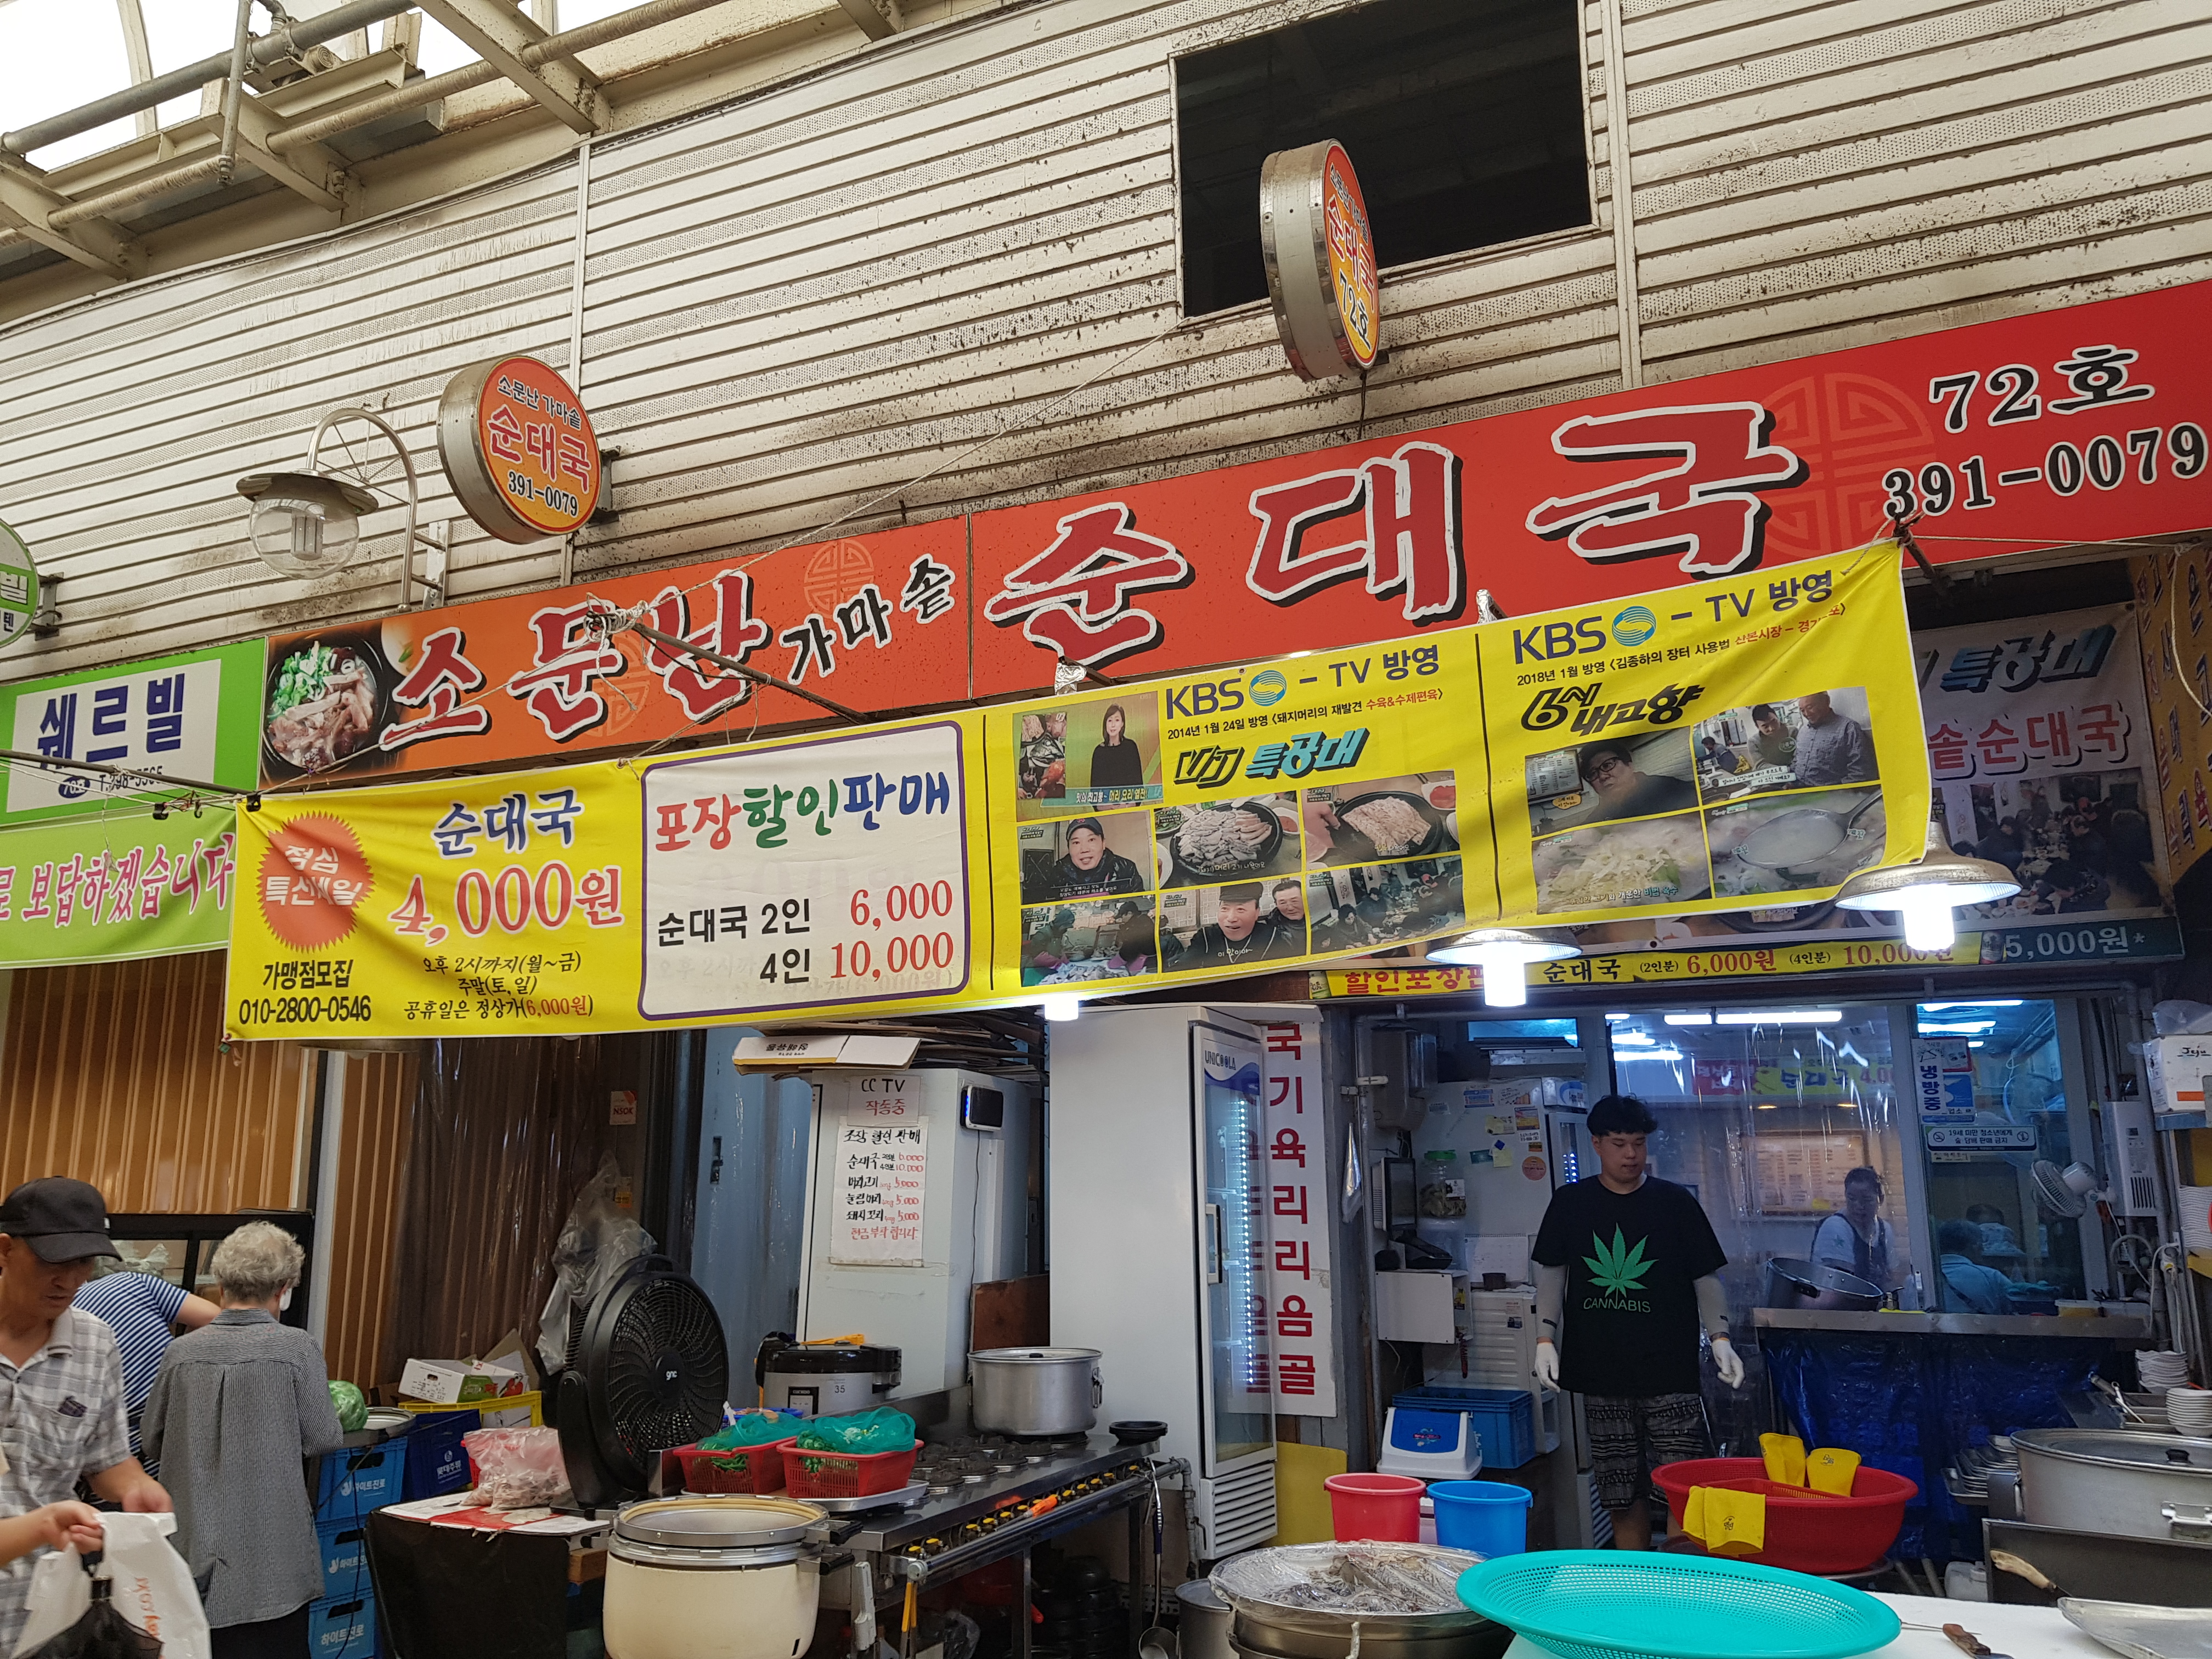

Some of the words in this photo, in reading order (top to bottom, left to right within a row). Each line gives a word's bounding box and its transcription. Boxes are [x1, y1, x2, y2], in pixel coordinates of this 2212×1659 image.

[1327, 194, 1375, 314] 순대국
[1339, 267, 1372, 352] 72호
[497, 374, 540, 411] 소문난
[541, 394, 582, 431] 가마솥
[1928, 343, 2155, 434] 72호
[487, 404, 591, 494] 순대국
[1882, 421, 2209, 521] 391-0079
[508, 469, 579, 517] 391-0079
[380, 568, 772, 751] 소문난
[779, 552, 957, 686] 가마솥
[983, 399, 1810, 669] 순대국
[1513, 616, 1606, 664] KBS
[1706, 588, 1756, 622] TV
[1769, 569, 1833, 611] 방영
[1166, 677, 1245, 720] KBS
[1328, 658, 1372, 687] TV
[1382, 644, 1440, 680] 방영
[1517, 670, 1556, 686] 2018년
[1560, 667, 1578, 680] 1월
[1582, 661, 1606, 676] 방영
[1667, 646, 1690, 661] 장터
[1695, 638, 1731, 656] 사용법
[1735, 625, 1782, 646] 산본시장
[1940, 623, 2117, 693] 특공대
[37, 673, 185, 770] 쉐르빌
[1167, 725, 1201, 740] 2014년
[1204, 722, 1220, 734] 1월
[1223, 719, 1245, 732] 24일
[1248, 715, 1268, 728] 방영
[1331, 701, 1363, 715] 재발견
[1521, 682, 1602, 731] 6시
[1570, 682, 1705, 736] 내고향
[1173, 744, 1245, 789] VJ
[1244, 727, 1371, 778] 특공대
[430, 785, 584, 859] 순대국
[21, 832, 236, 928] 보답하겠습니다
[387, 859, 625, 947] 4,000원
[658, 905, 748, 947] 순대국
[761, 898, 811, 935] 2인
[850, 879, 953, 931] 6,000
[262, 959, 354, 991] 가맹점모집
[423, 955, 449, 974] 오후
[455, 951, 582, 974] 2시까지(월~금)
[759, 948, 811, 985] 4인
[831, 932, 954, 983] 10,000
[1345, 966, 1483, 994] 할인포장판
[1543, 957, 1622, 984] 순대국
[1640, 960, 1679, 975] (2인분)
[1687, 949, 1777, 977] 6,000원
[1788, 951, 1831, 966] (4인분)
[239, 994, 372, 1025] 010-2800-0546
[404, 1000, 471, 1020] 공휴일은
[475, 994, 594, 1019] 정상가(6,000원)
[2182, 1045, 2207, 1058] Jeju
[866, 1098, 906, 1116] 작동중
[847, 1153, 881, 1170] 순대국
[871, 1128, 892, 1145] 할인
[895, 1128, 921, 1144] 판매
[1583, 1297, 1651, 1313] CANNABIS
[834, 1385, 845, 1393] 35
[339, 1557, 368, 1569] 하이트진
[321, 1624, 364, 1645] 하이트진로
